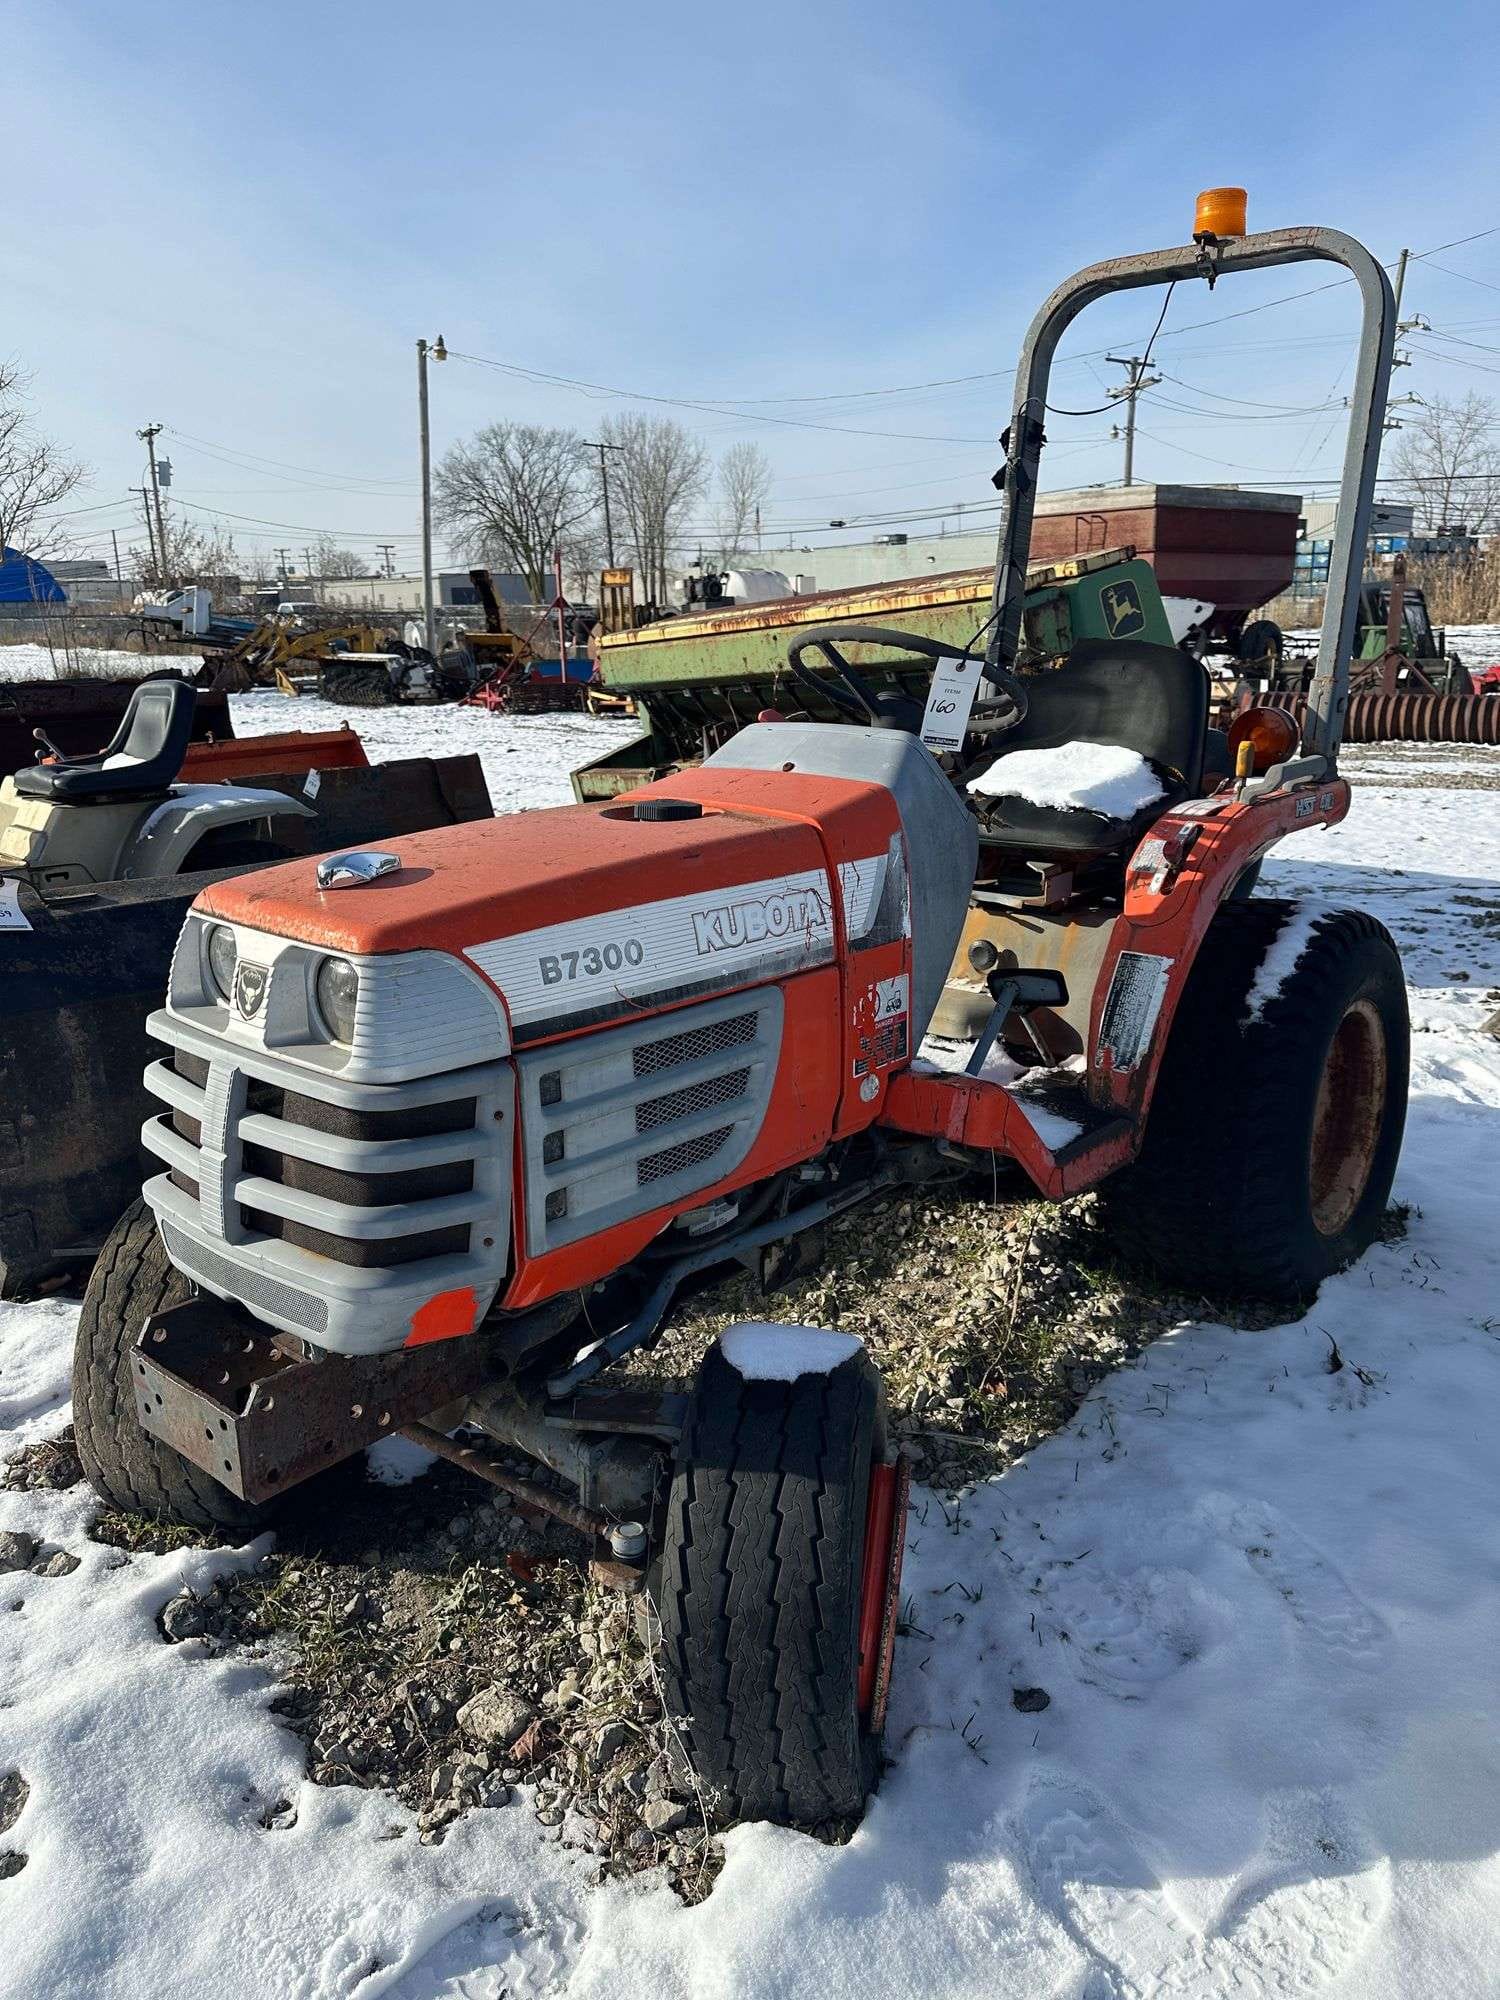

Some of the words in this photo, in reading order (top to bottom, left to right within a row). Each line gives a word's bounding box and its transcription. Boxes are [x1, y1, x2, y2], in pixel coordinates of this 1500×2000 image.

[930, 699, 956, 714] 160
[691, 888, 827, 955] KUBOTA
[539, 939, 644, 985] B7300
